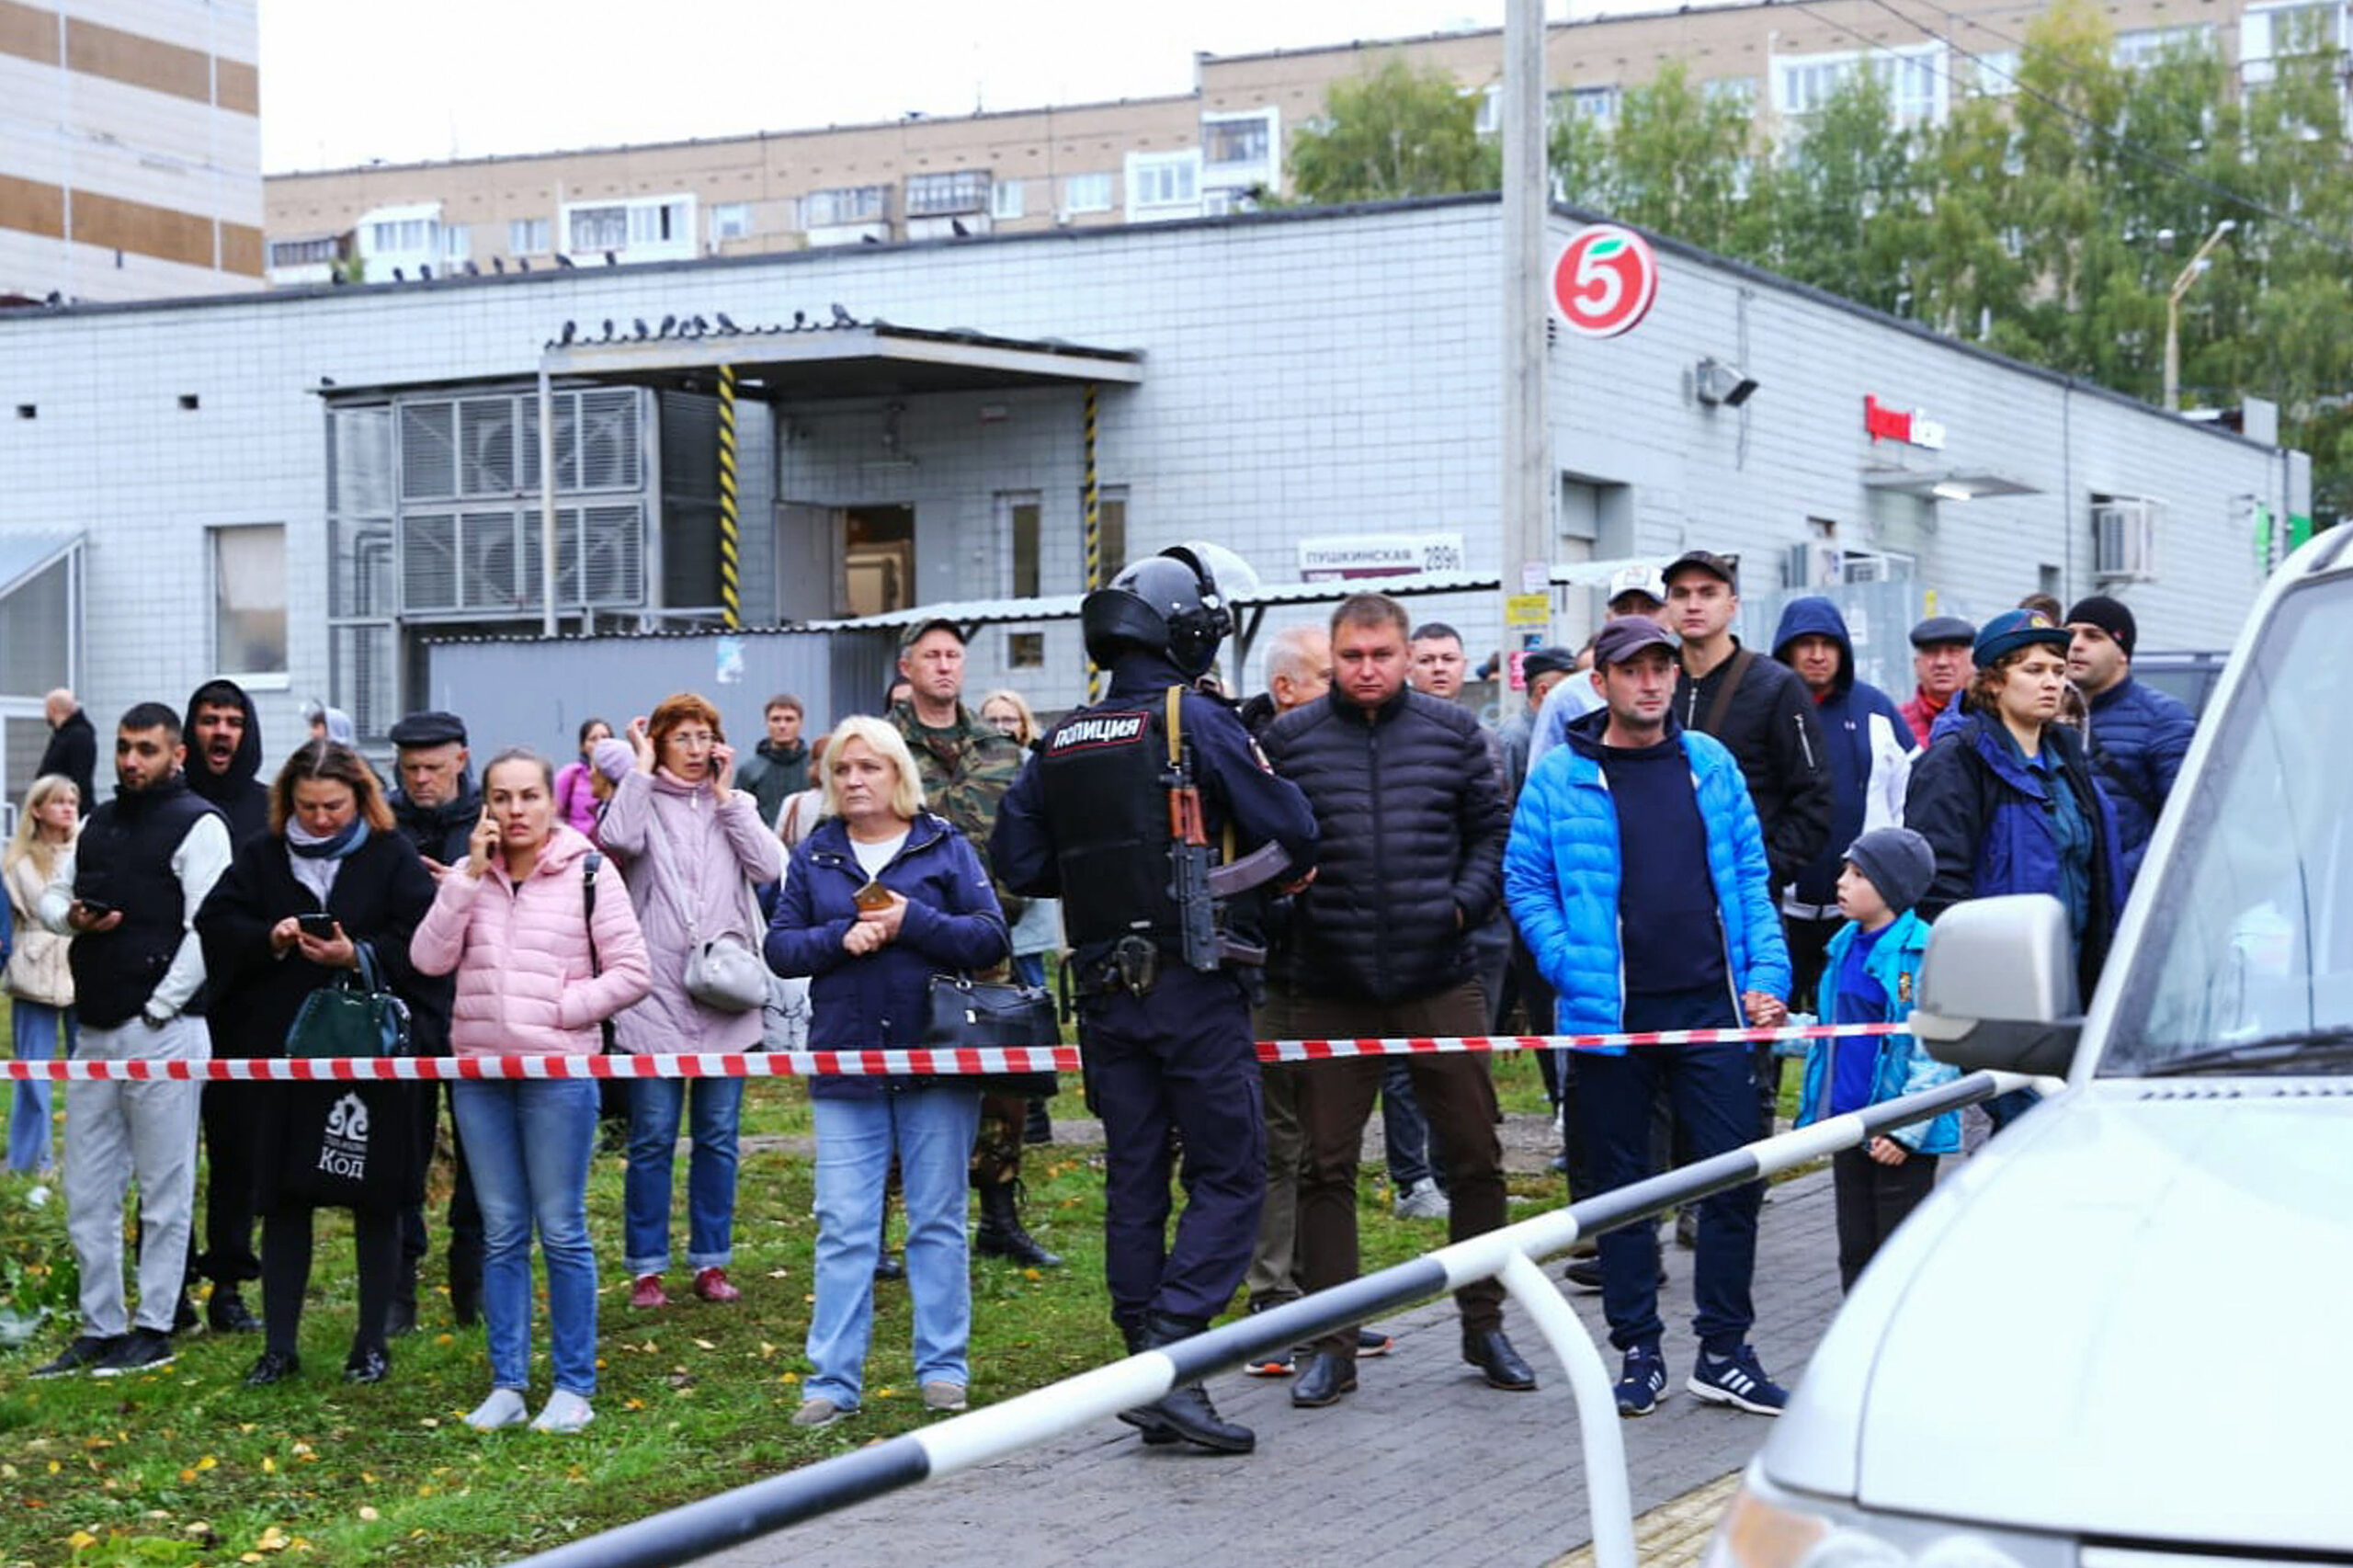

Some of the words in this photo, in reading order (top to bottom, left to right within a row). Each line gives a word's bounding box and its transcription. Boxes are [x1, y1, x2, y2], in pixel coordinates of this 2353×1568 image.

[1573, 234, 1631, 317] 5
[1306, 549, 1412, 564] ПУШКИНСКАЯ
[1053, 718, 1141, 748] ПОЛИЦИЯ
